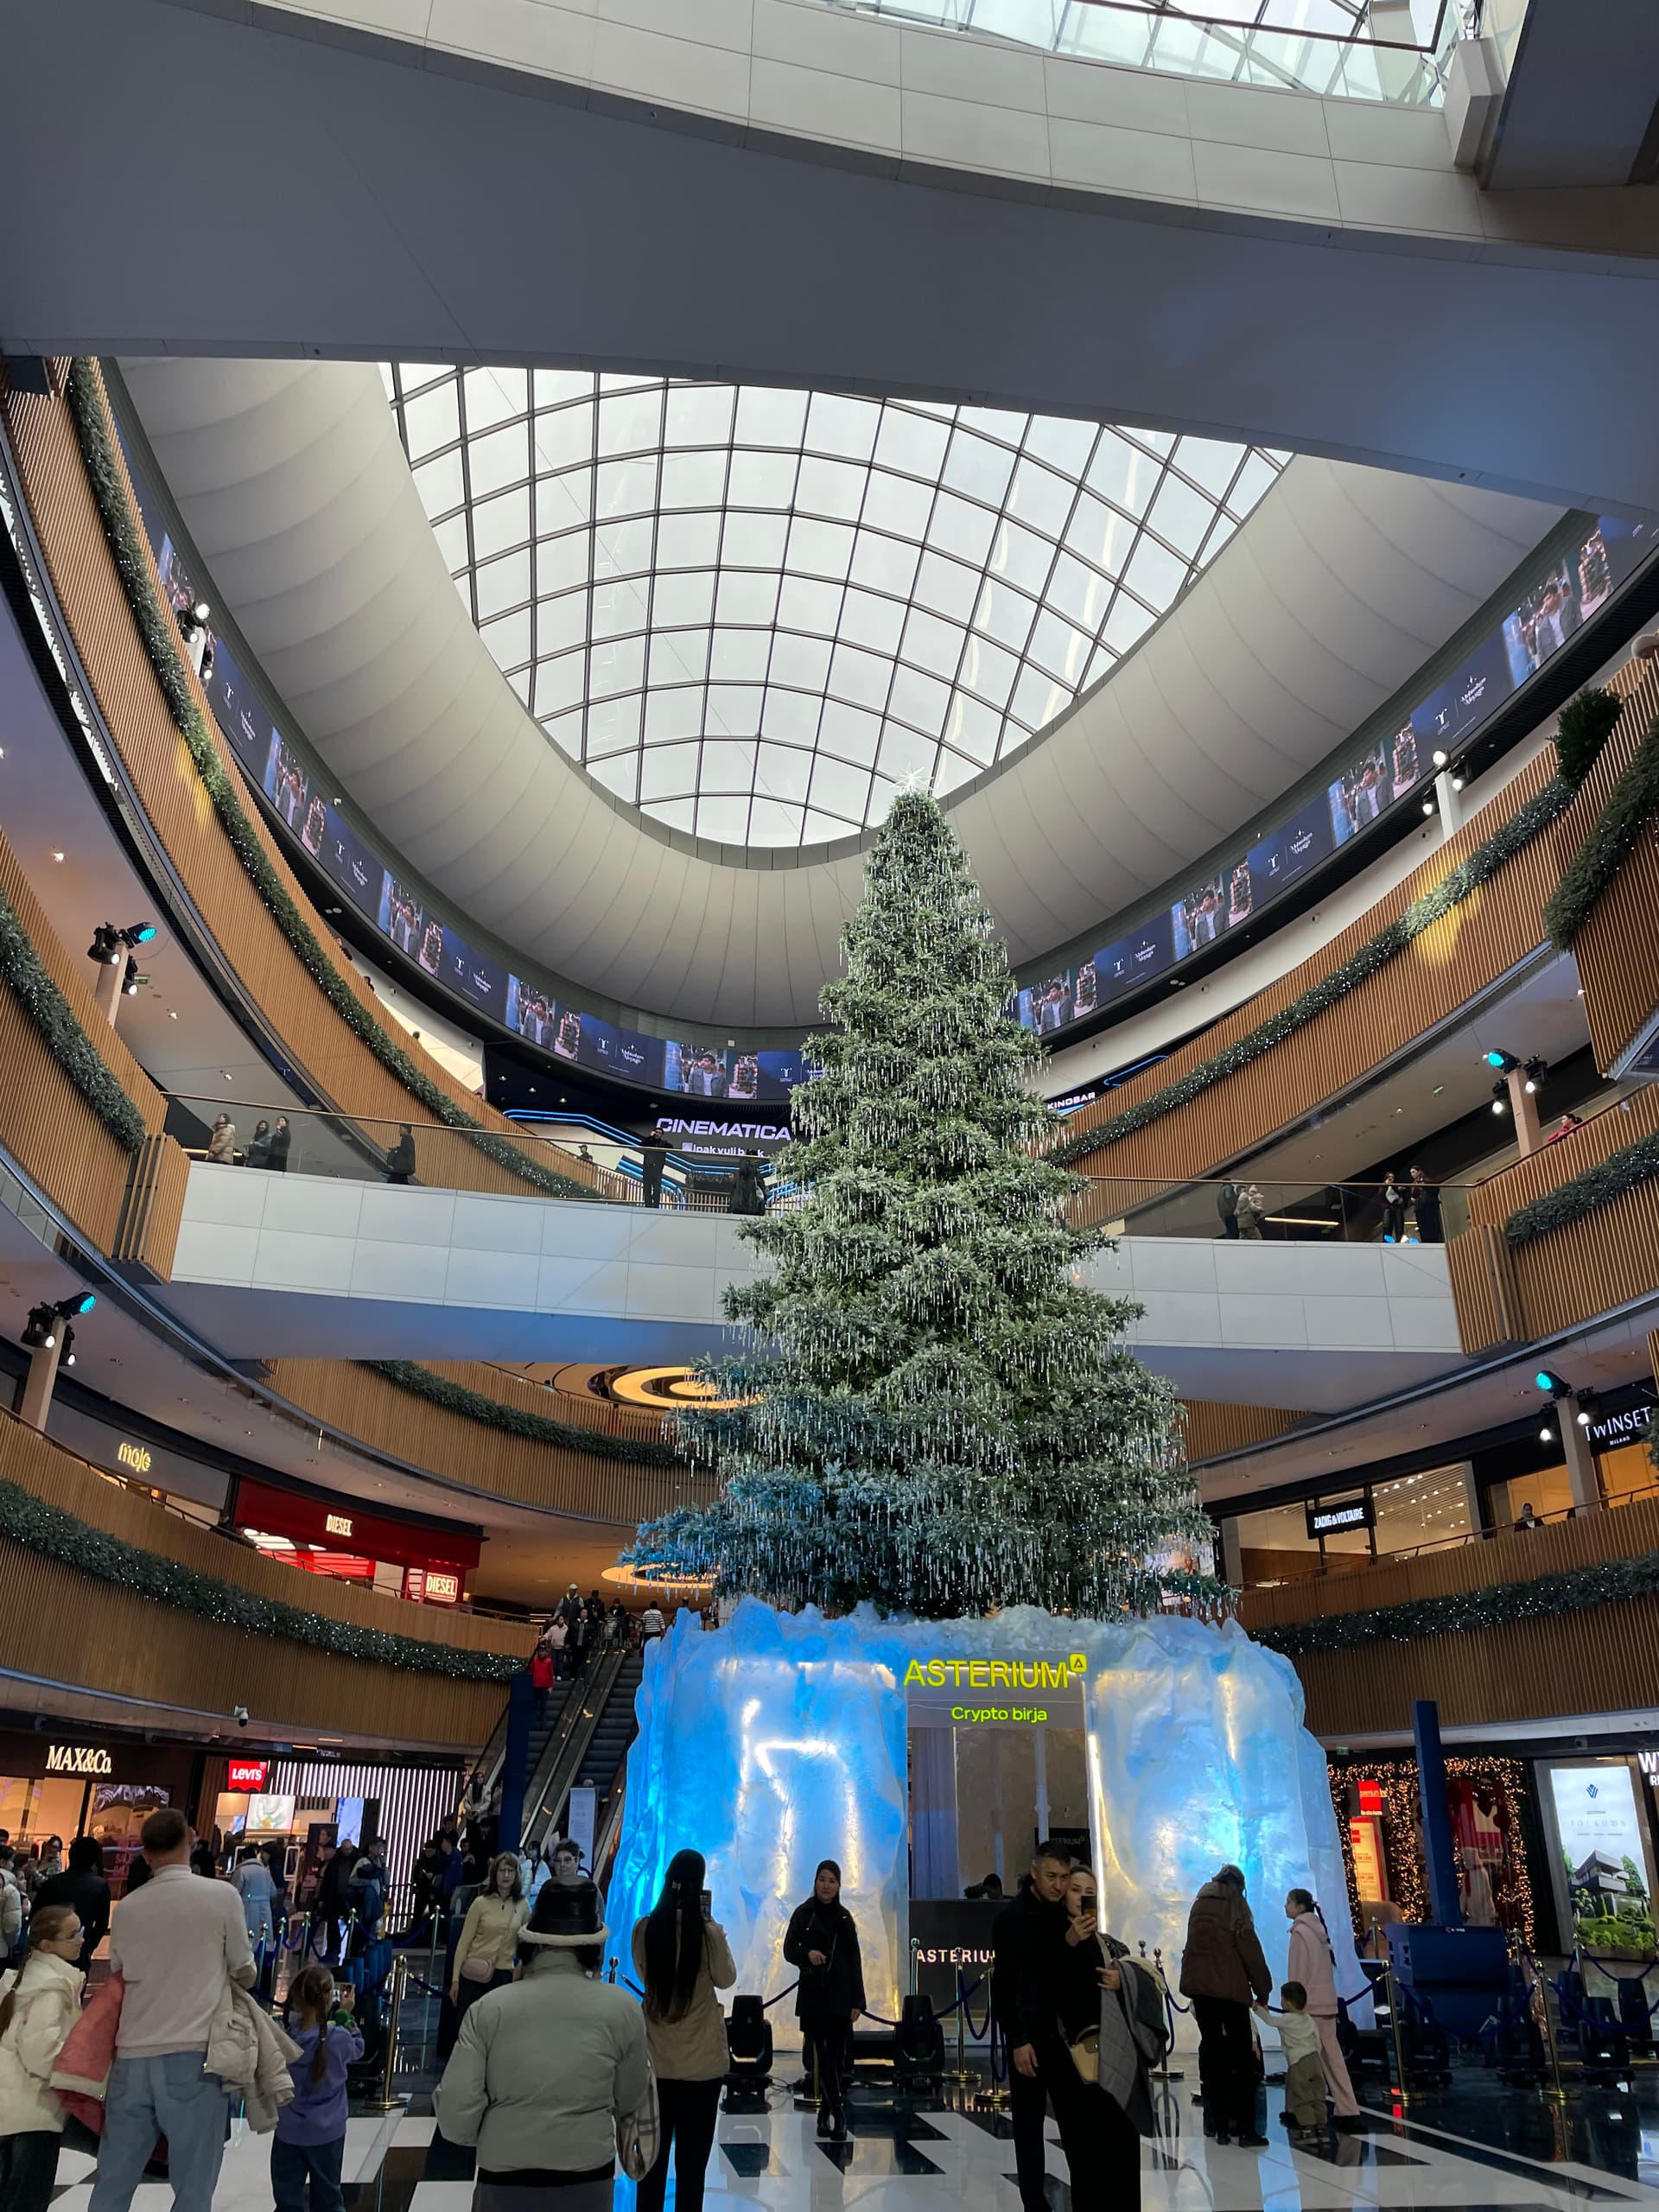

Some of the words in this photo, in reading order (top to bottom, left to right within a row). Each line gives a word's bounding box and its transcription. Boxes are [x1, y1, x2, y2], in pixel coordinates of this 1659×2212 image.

[1047, 1091, 1096, 1110] KINOBAR
[656, 1117, 791, 1141] CINEMATICA
[738, 1147, 765, 1158] bk
[326, 1514, 353, 1536] DIESEL
[426, 1575, 455, 1595] DIESEL
[904, 1659, 1069, 1688] ASTERIUM
[950, 1707, 1008, 1722] Crypto
[1012, 1707, 1048, 1723] birja
[917, 1949, 995, 1963] ASTERIU
